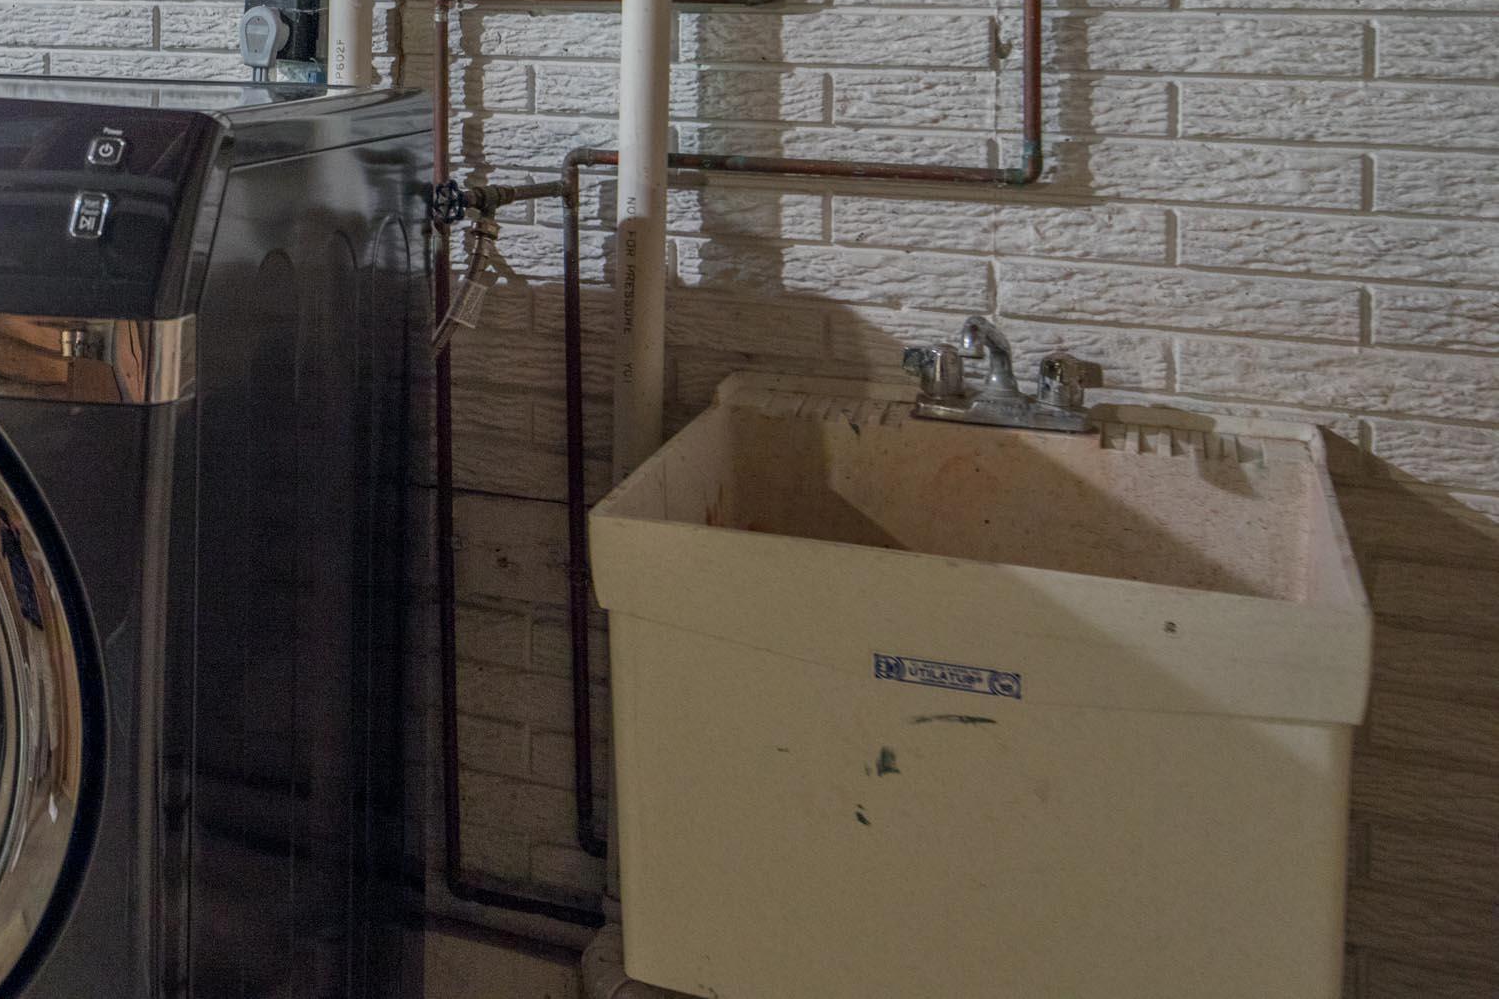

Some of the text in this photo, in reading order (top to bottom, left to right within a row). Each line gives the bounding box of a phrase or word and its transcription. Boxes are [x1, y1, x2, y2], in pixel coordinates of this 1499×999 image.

[334, 39, 346, 84] P602F
[625, 230, 636, 257] FOR
[623, 264, 636, 336] PRESSURE
